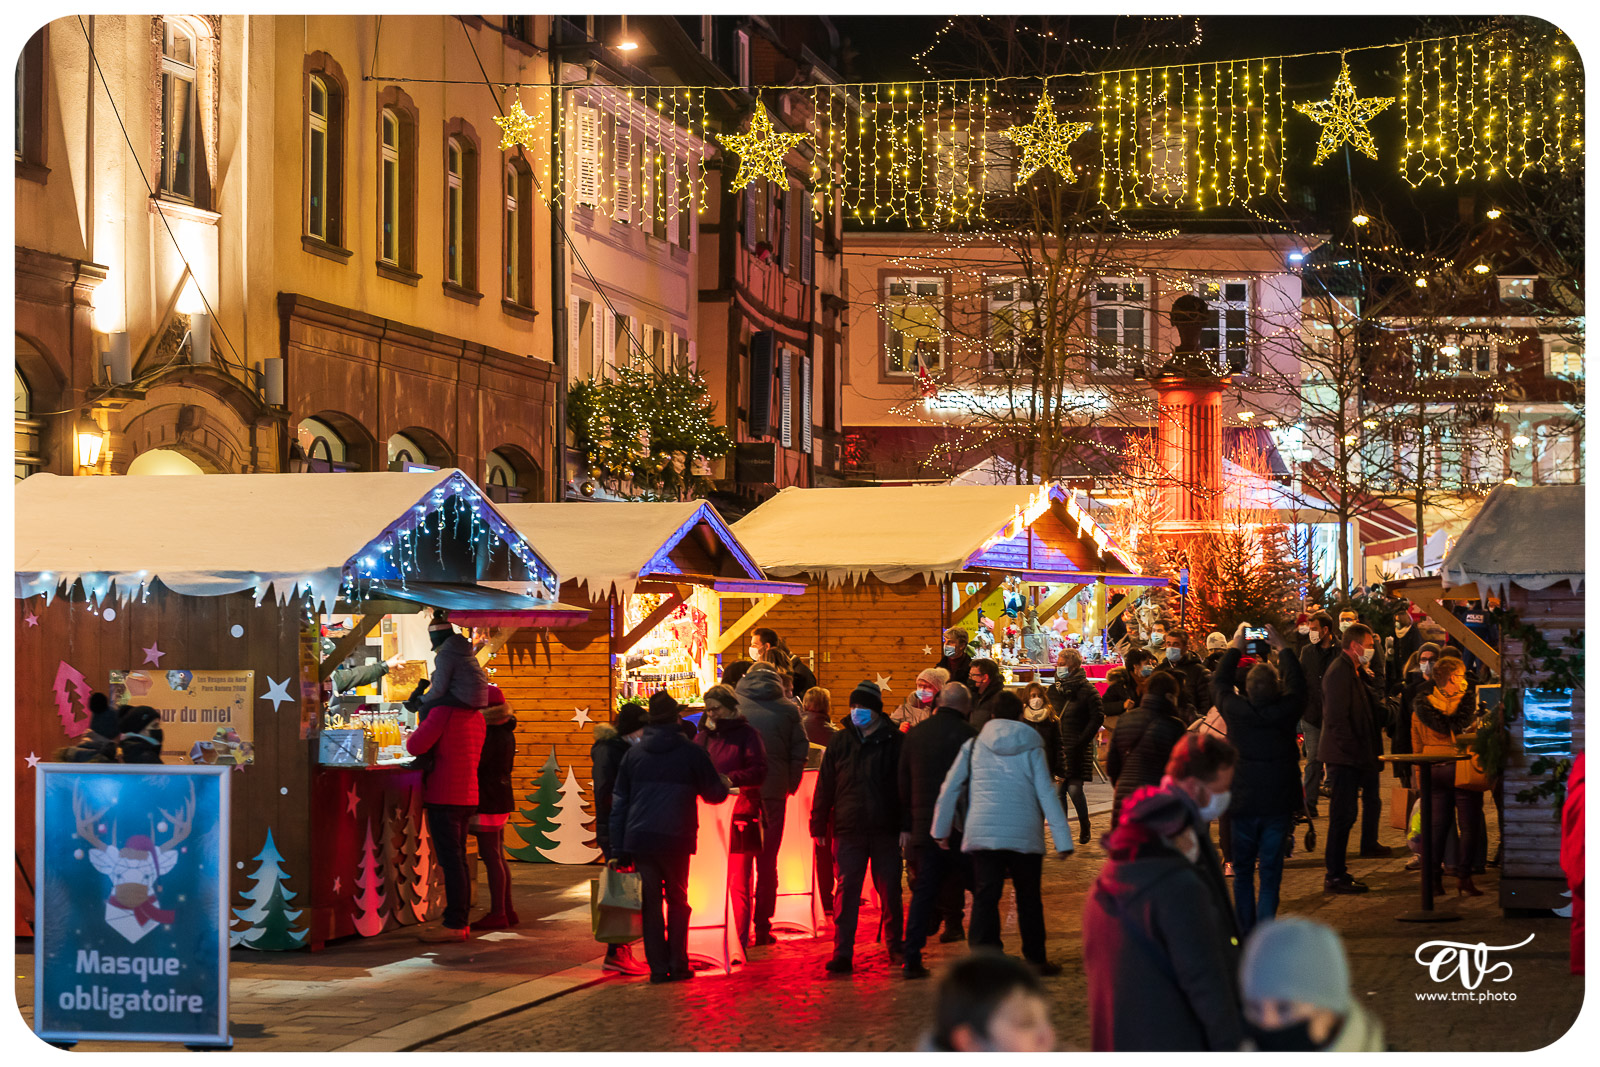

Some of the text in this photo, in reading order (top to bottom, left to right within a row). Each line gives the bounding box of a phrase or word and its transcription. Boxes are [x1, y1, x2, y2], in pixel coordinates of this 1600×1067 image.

[927, 393, 1034, 409] RESTAURANT
[181, 706, 197, 723] du
[201, 706, 231, 723] miel
[75, 949, 180, 983] Masque
[58, 984, 204, 1020] obligatoire
